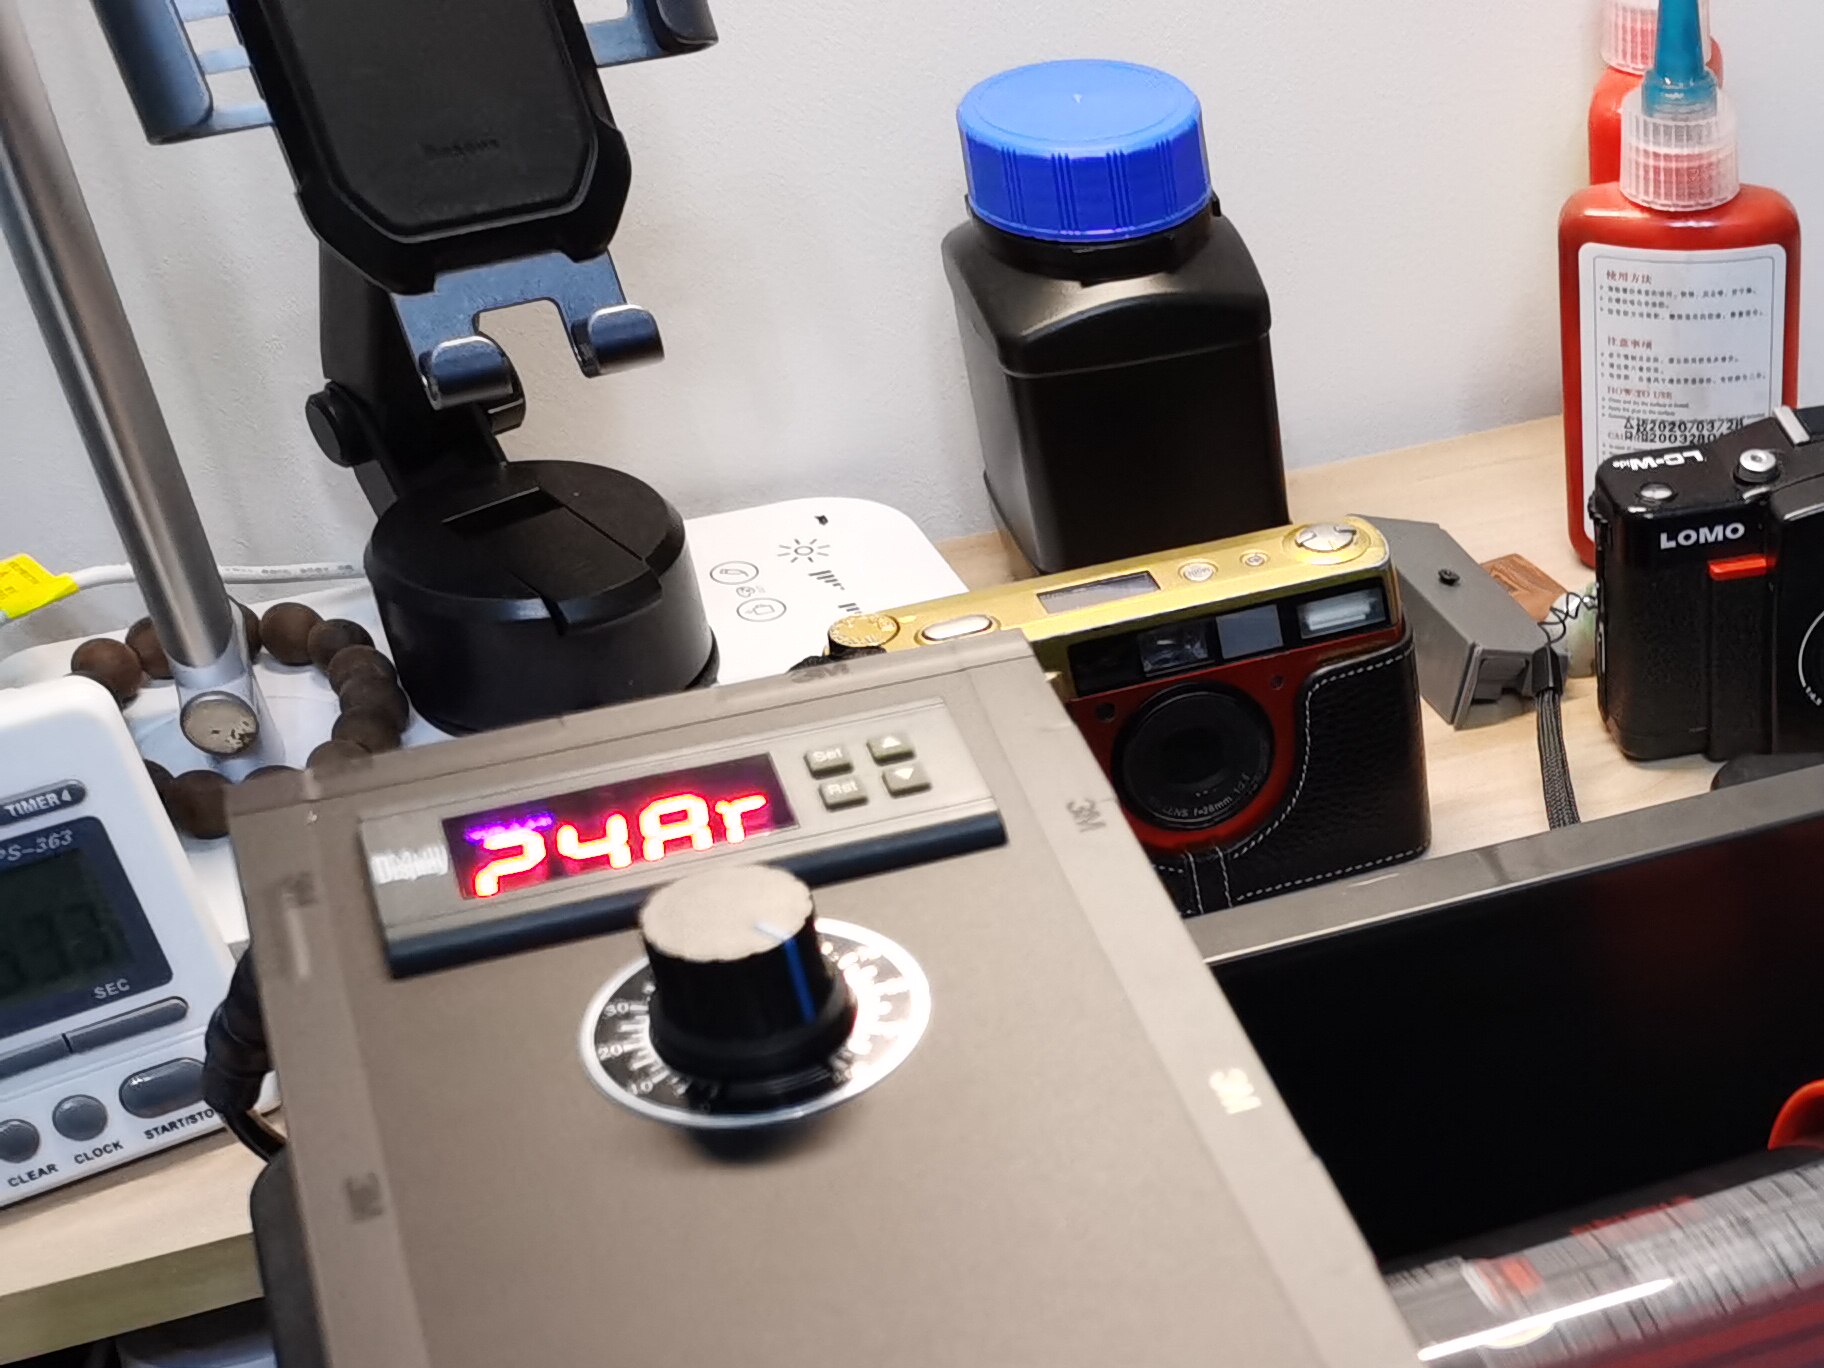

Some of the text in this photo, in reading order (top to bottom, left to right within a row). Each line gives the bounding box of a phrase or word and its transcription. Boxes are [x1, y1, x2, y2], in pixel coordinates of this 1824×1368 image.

[1660, 522, 1746, 550] LOMO
[812, 747, 842, 763] Set
[826, 780, 858, 796] Rst
[3, 792, 61, 818] TIMER
[94, 978, 130, 999] SEC
[598, 1044, 623, 1061] 20
[144, 1107, 215, 1140] START/STO
[74, 1139, 124, 1165] CLOCK
[8, 1163, 59, 1188] CLEAR
